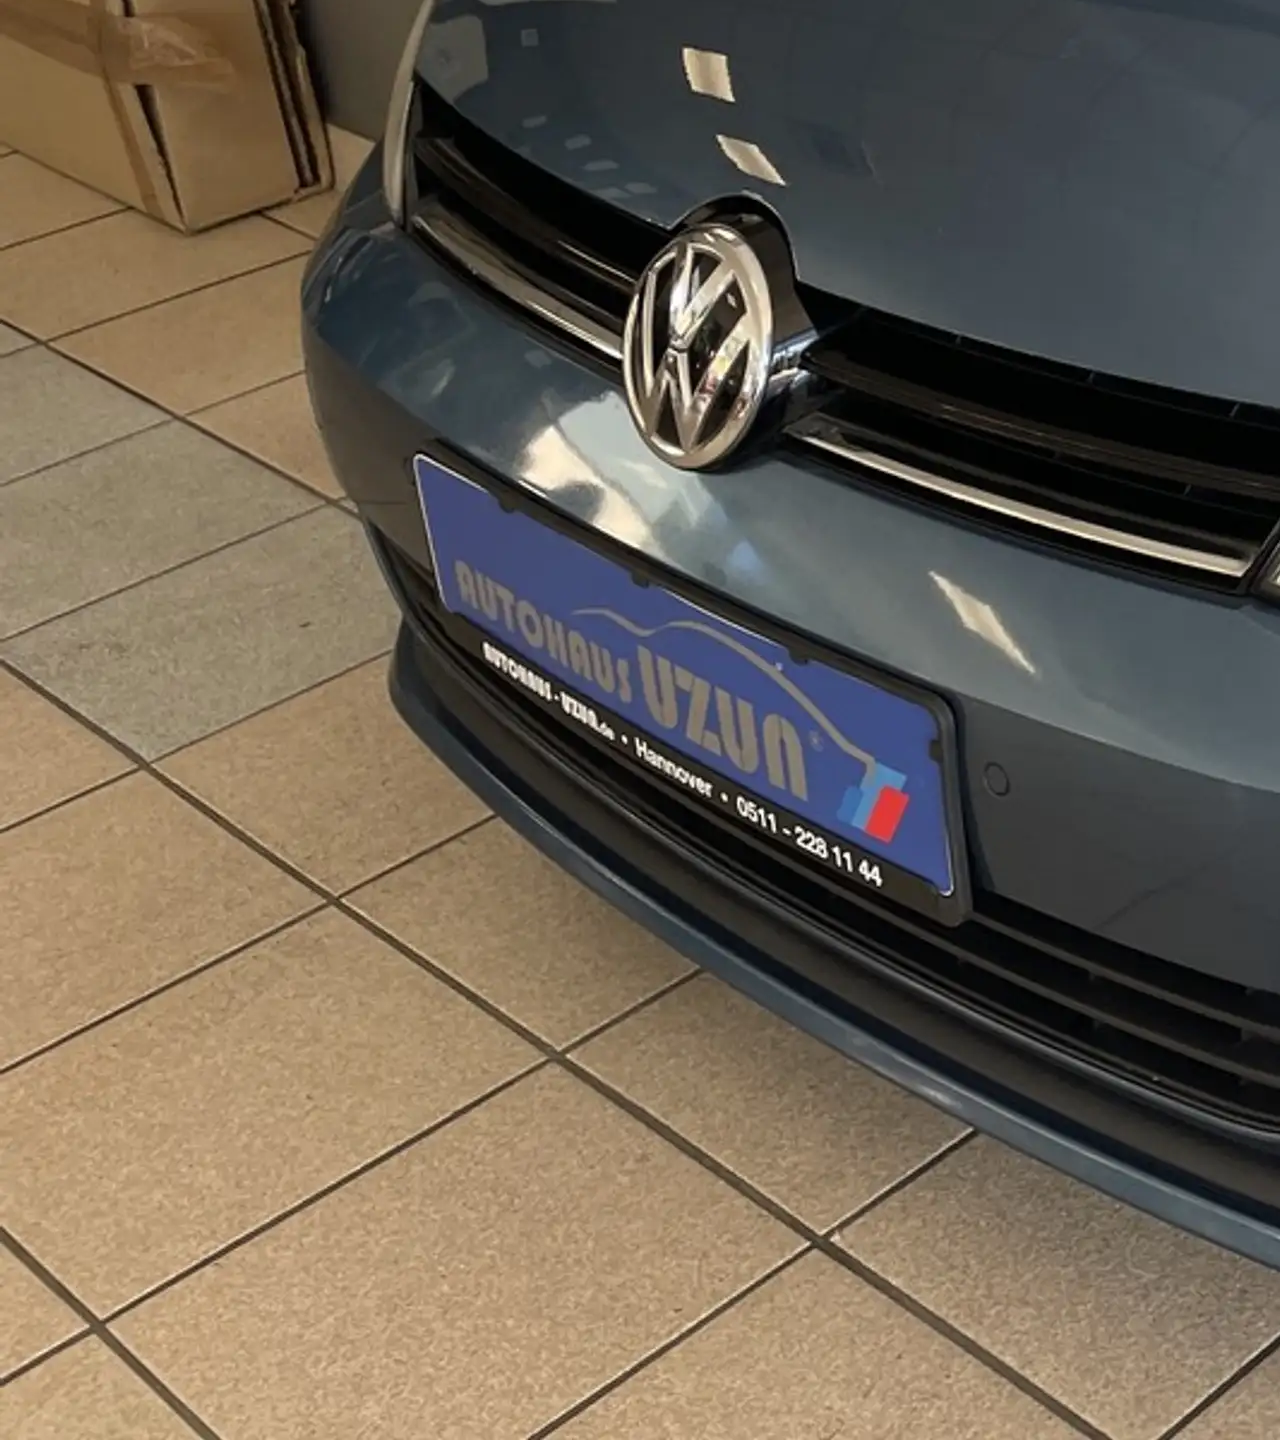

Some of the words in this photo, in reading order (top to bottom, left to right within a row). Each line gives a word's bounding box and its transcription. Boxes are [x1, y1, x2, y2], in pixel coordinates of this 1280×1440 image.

[454, 560, 633, 704] AUTOHAUS
[636, 645, 809, 803] UZUN
[633, 736, 714, 799] Hannover
[735, 795, 777, 834] 0511
[793, 824, 829, 860] 228
[831, 844, 854, 873] 11
[857, 859, 884, 888] 44
